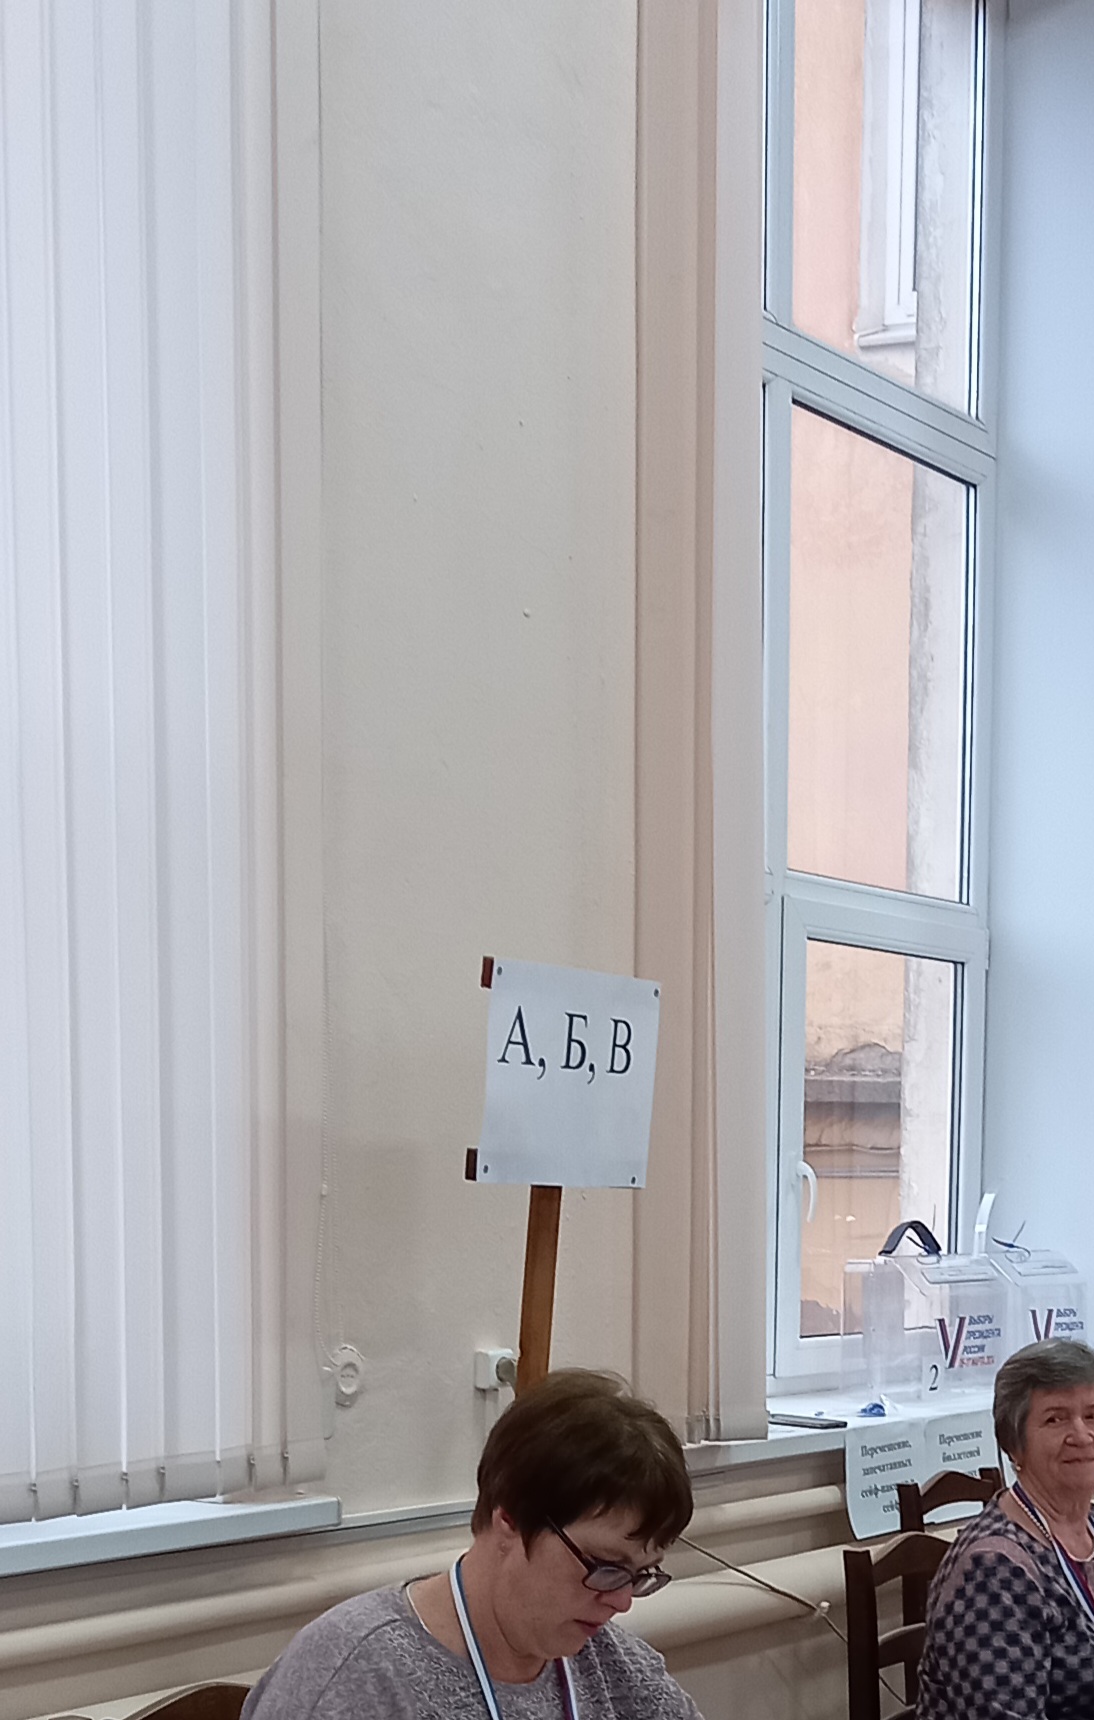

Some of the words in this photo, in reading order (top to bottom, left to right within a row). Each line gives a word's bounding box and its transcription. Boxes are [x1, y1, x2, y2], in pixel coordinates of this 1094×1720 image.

[496, 1004, 546, 1081] А,
[559, 1011, 596, 1085] Б,
[605, 1017, 632, 1075] В
[928, 1364, 939, 1392] 2
